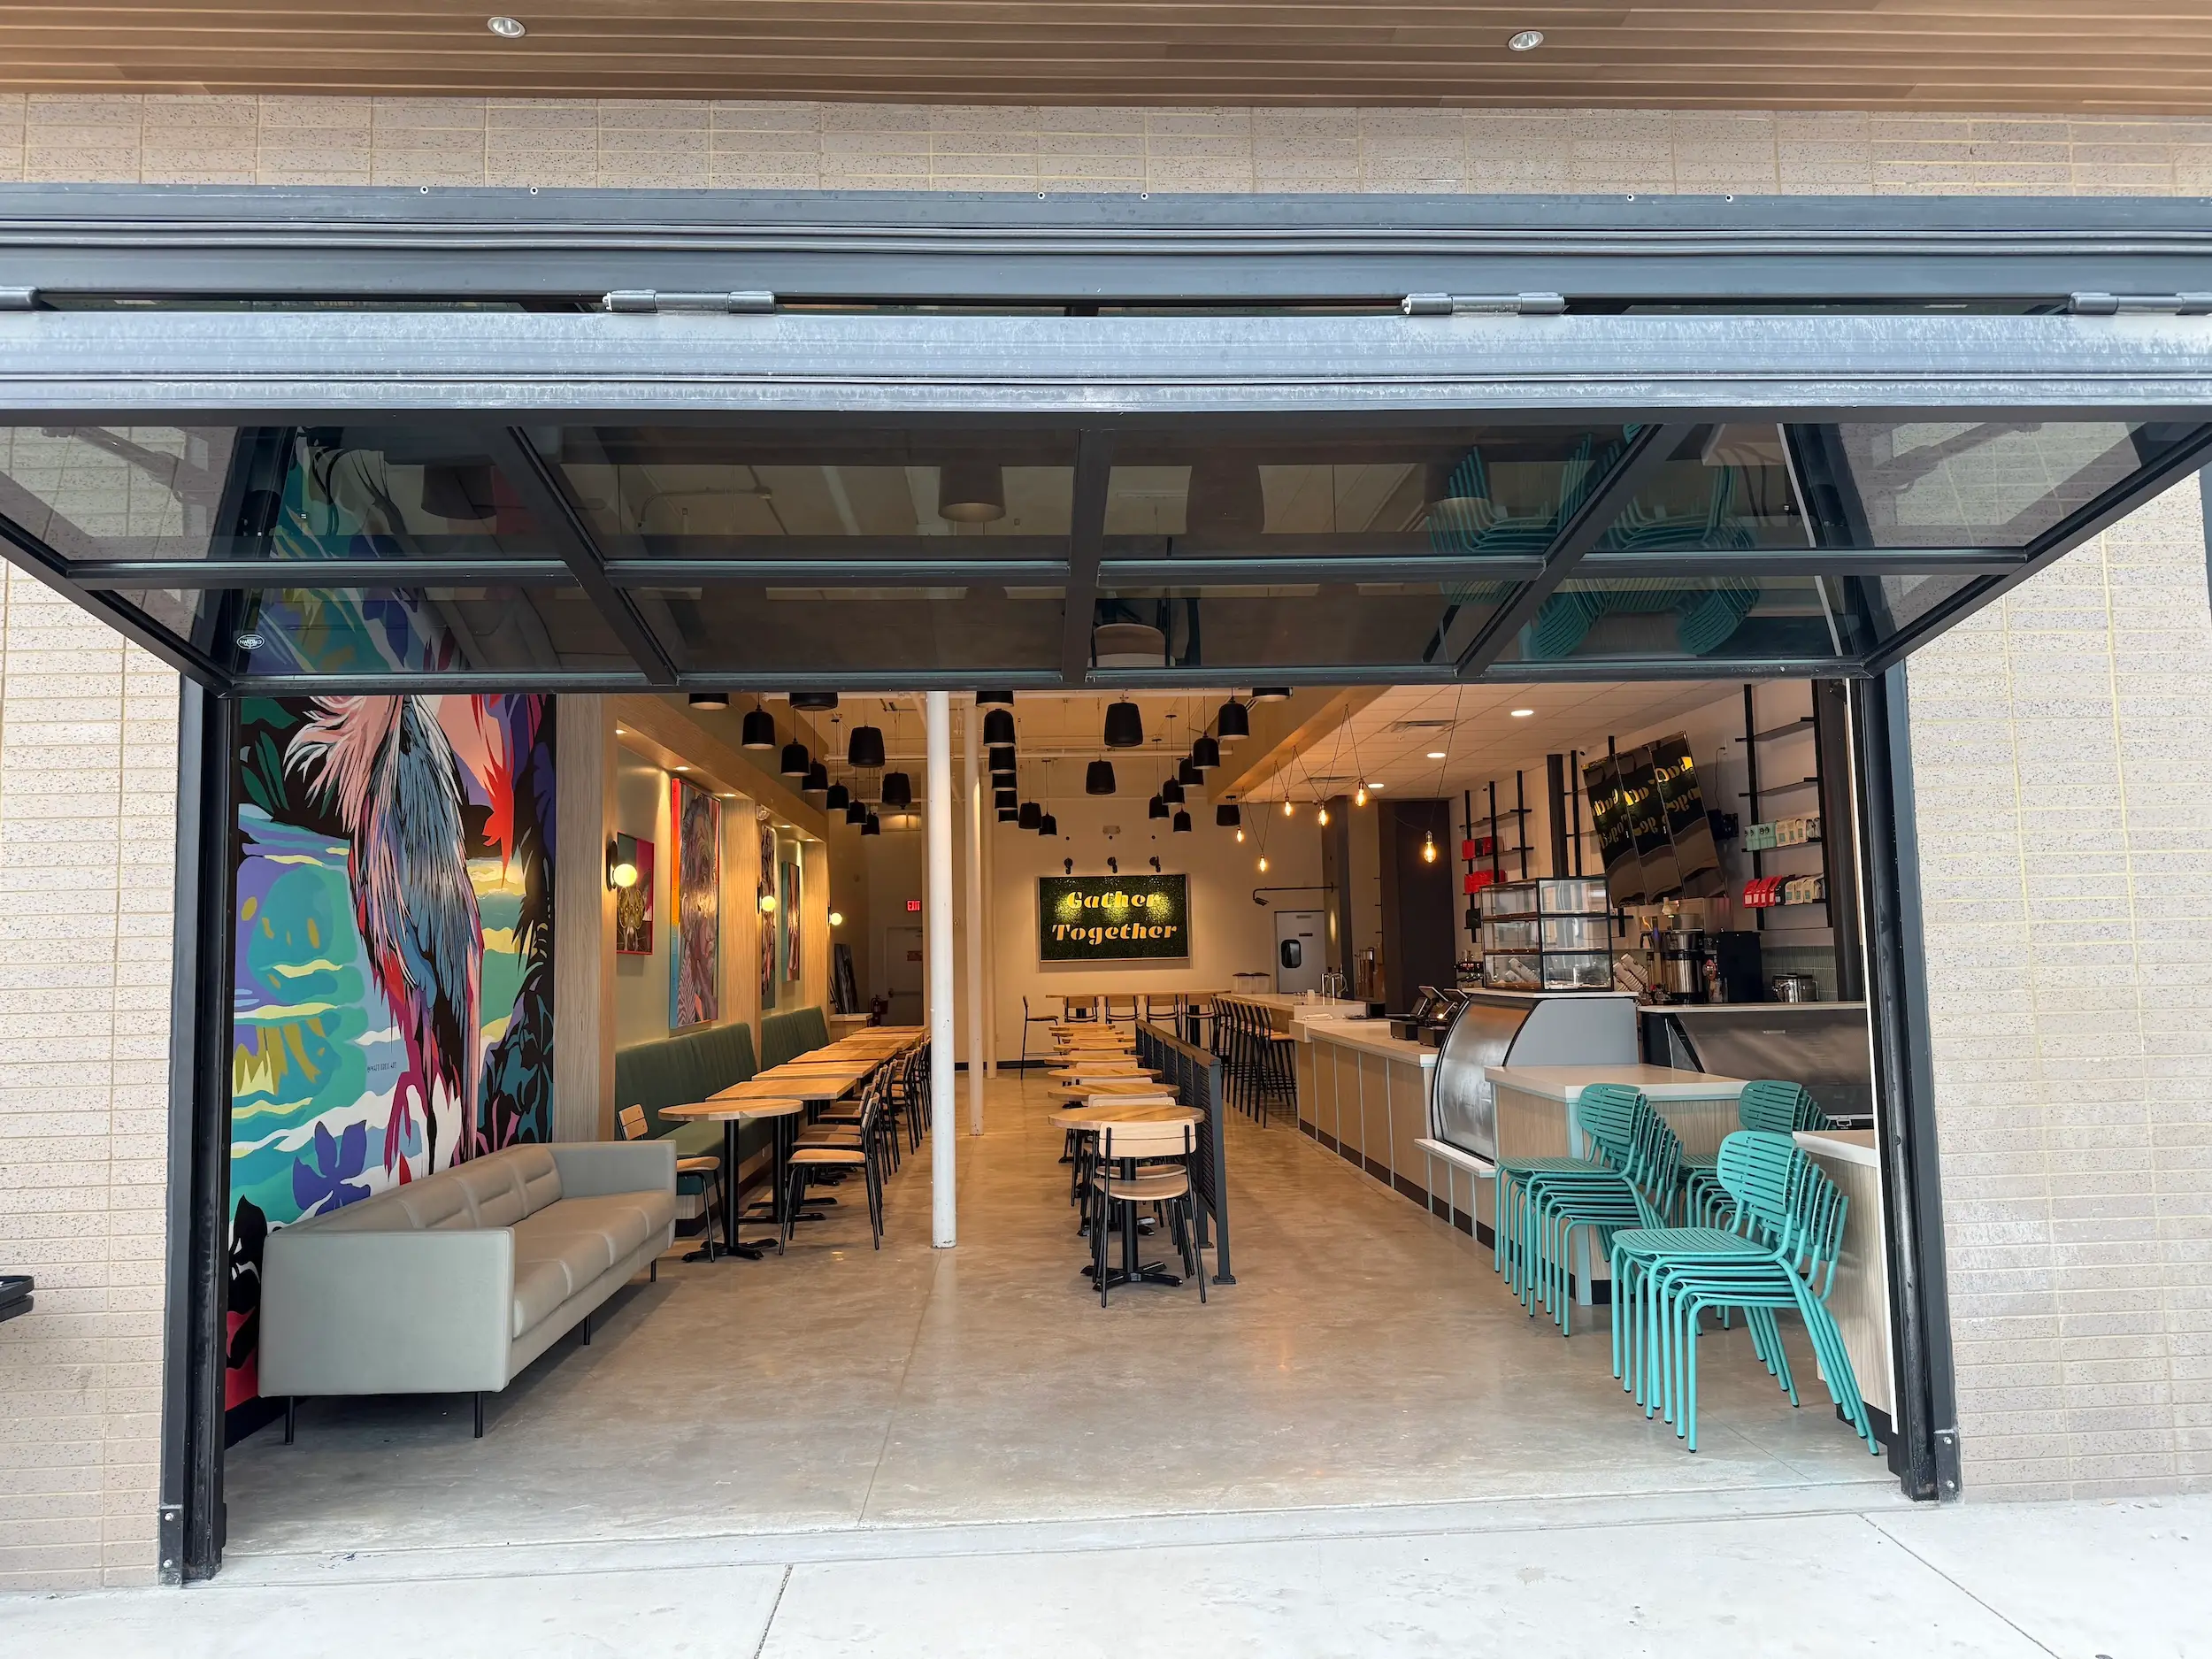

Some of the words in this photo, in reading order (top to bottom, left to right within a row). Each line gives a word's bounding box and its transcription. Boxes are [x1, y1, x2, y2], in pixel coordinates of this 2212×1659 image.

[907, 900, 920, 911] EXIT
[1066, 890, 1160, 909] Gather
[1051, 922, 1178, 946] Together
